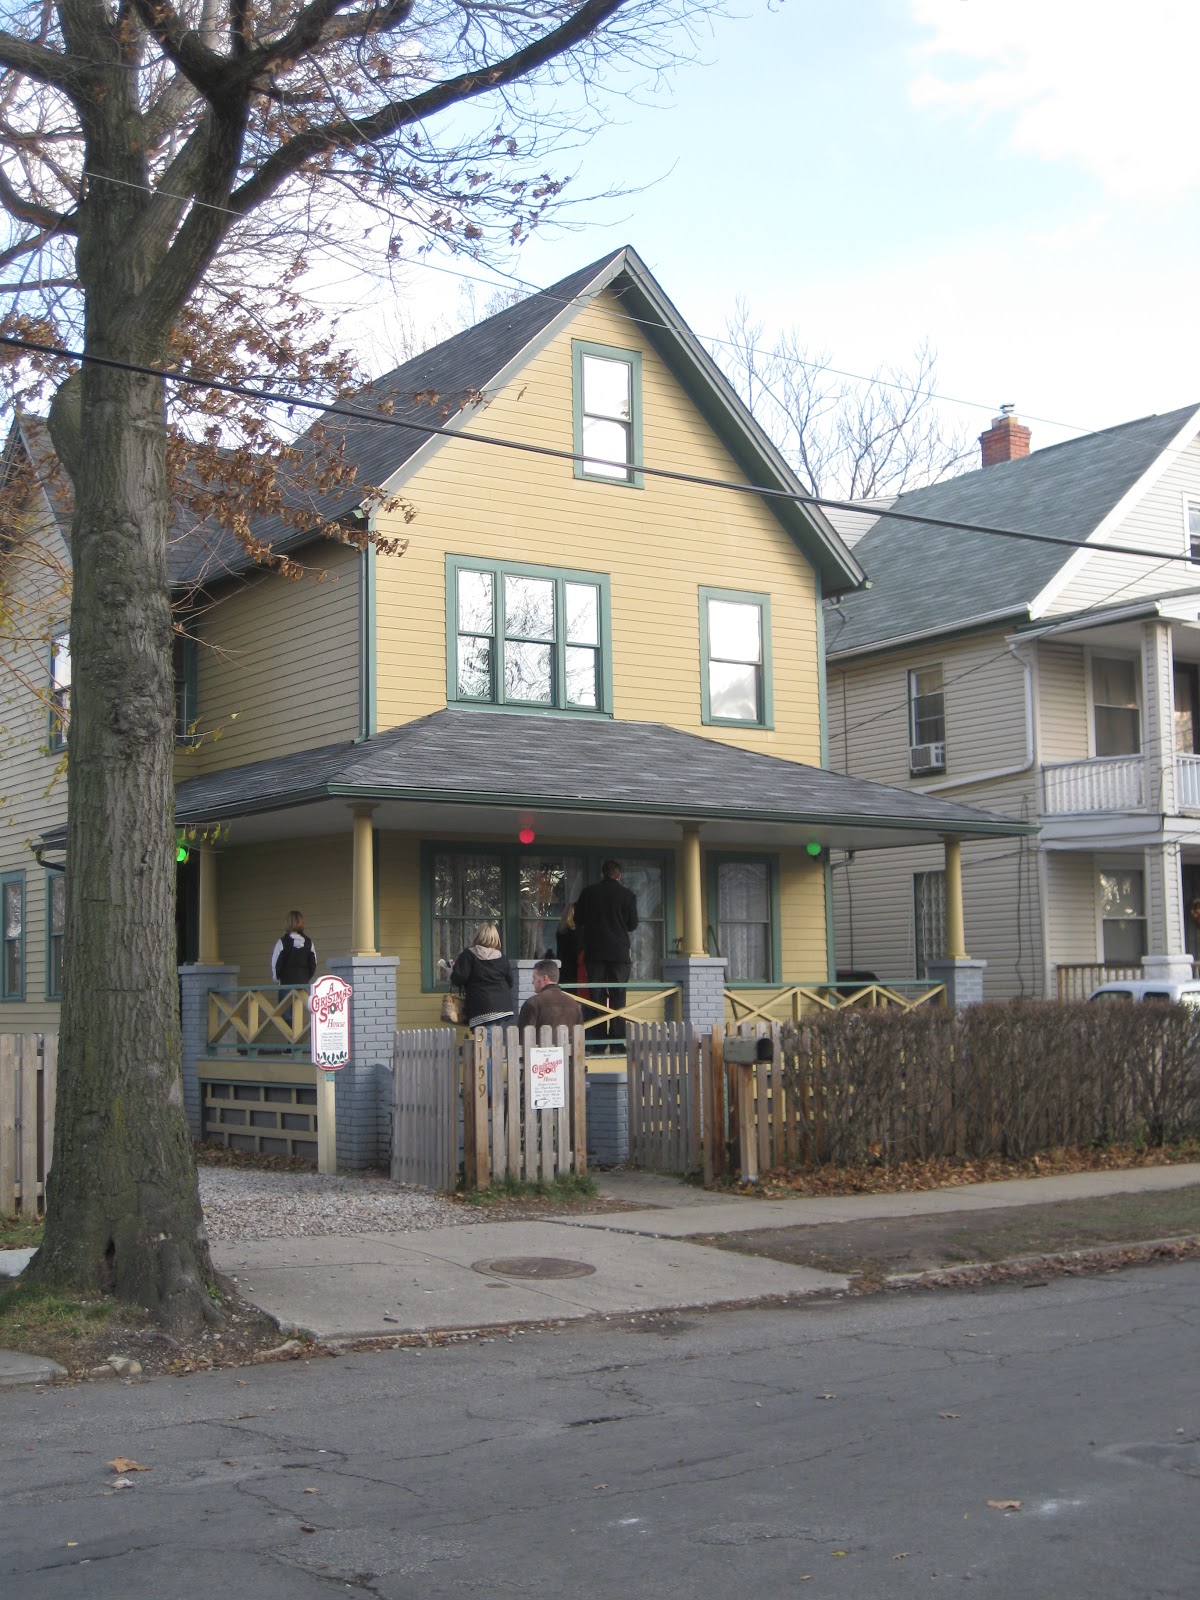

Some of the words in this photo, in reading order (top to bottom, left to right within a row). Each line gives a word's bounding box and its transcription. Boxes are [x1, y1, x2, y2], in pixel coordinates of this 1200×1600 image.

[311, 986, 352, 1012] CHRISTMAS
[319, 998, 346, 1023] STORY
[327, 1018, 346, 1028] House
[477, 1028, 486, 1098] 3159
